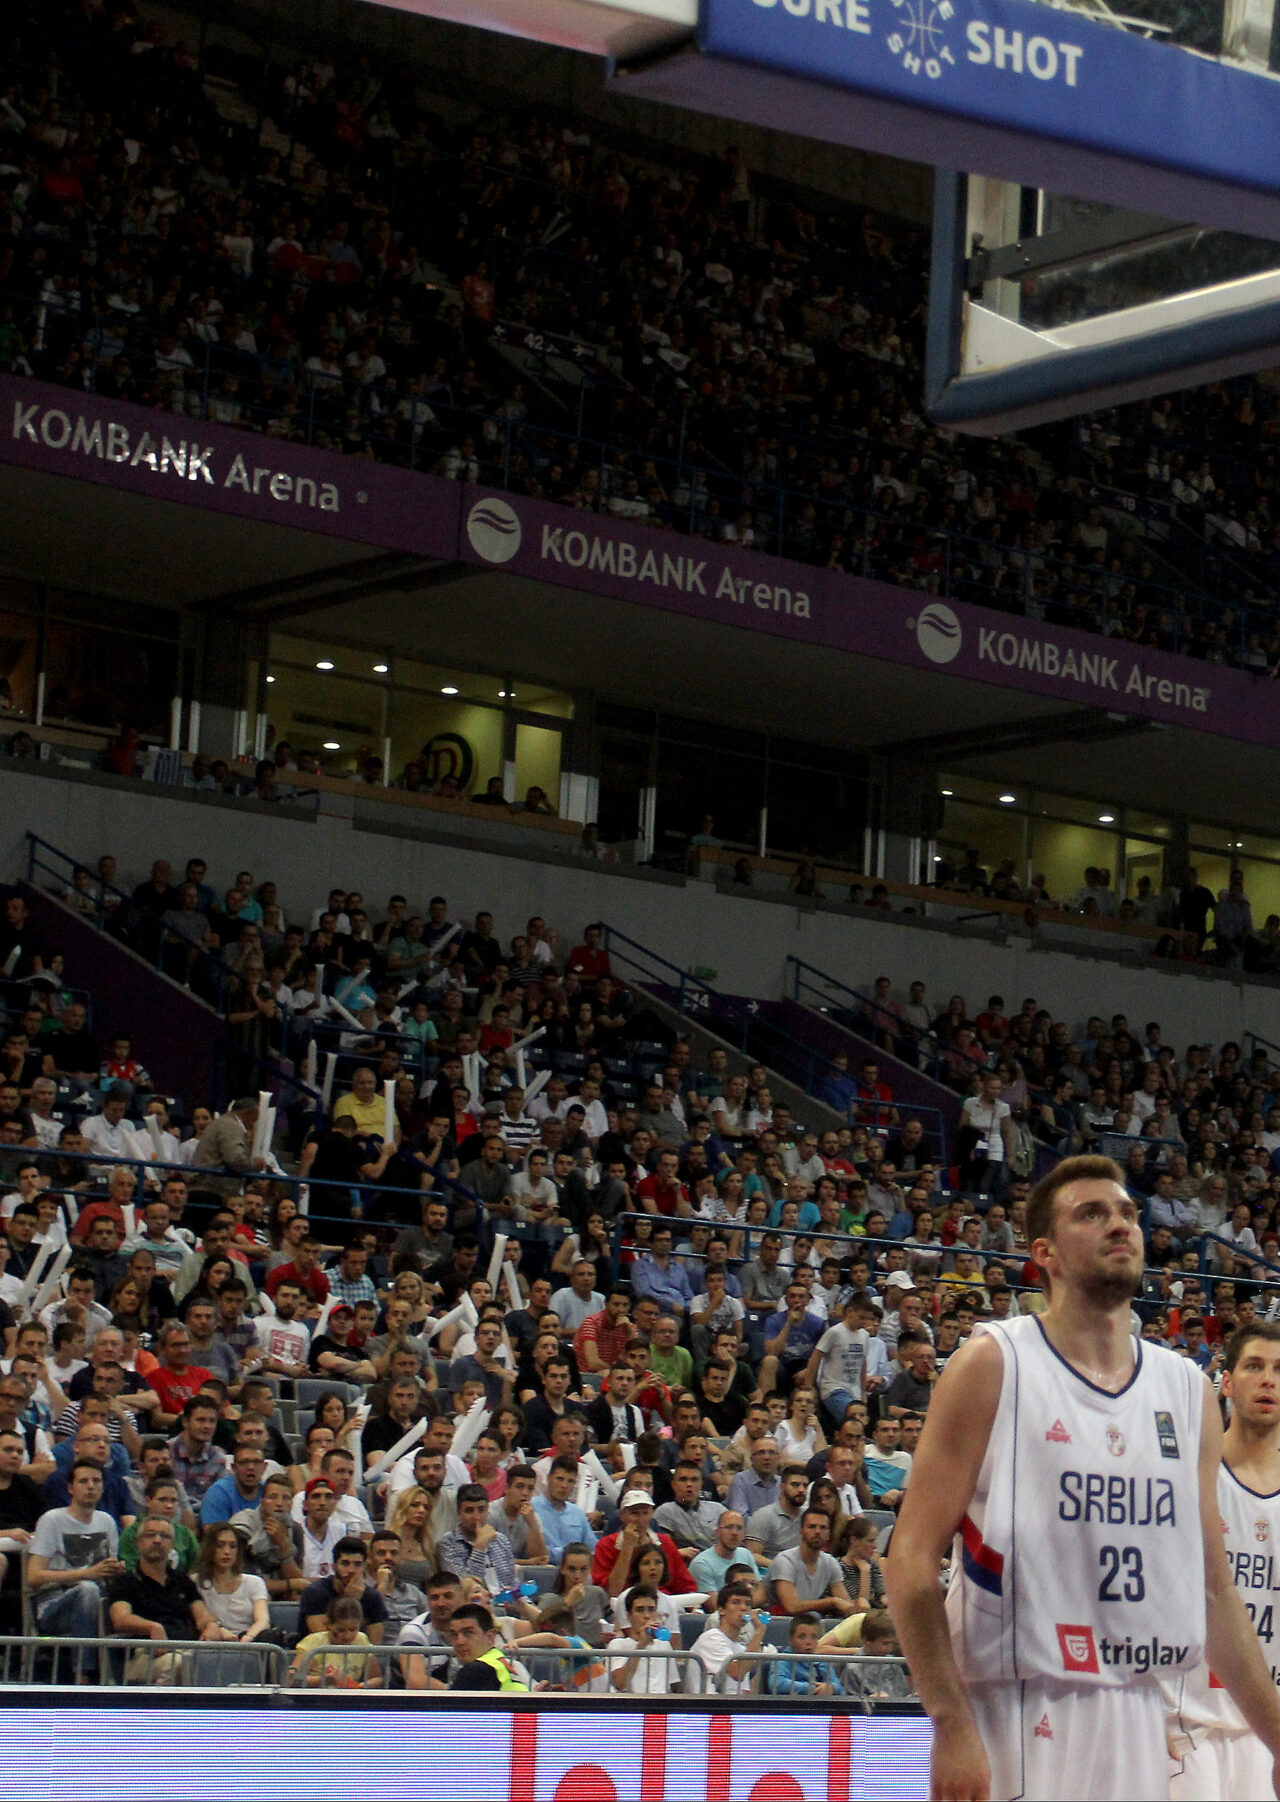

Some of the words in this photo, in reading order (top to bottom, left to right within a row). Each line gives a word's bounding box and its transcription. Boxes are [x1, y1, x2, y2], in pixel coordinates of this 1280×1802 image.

[966, 20, 1083, 87] SHOT
[13, 401, 214, 484] KOMBANK
[224, 454, 339, 512] Arena
[541, 525, 706, 595] KOMBANK
[715, 566, 812, 618] Arena
[978, 628, 1119, 690] KOMBANK
[1125, 664, 1207, 712] Arena
[1059, 1471, 1175, 1527] SRBIJA
[1099, 1546, 1145, 1602] 23
[1100, 1637, 1188, 1674] triglav
